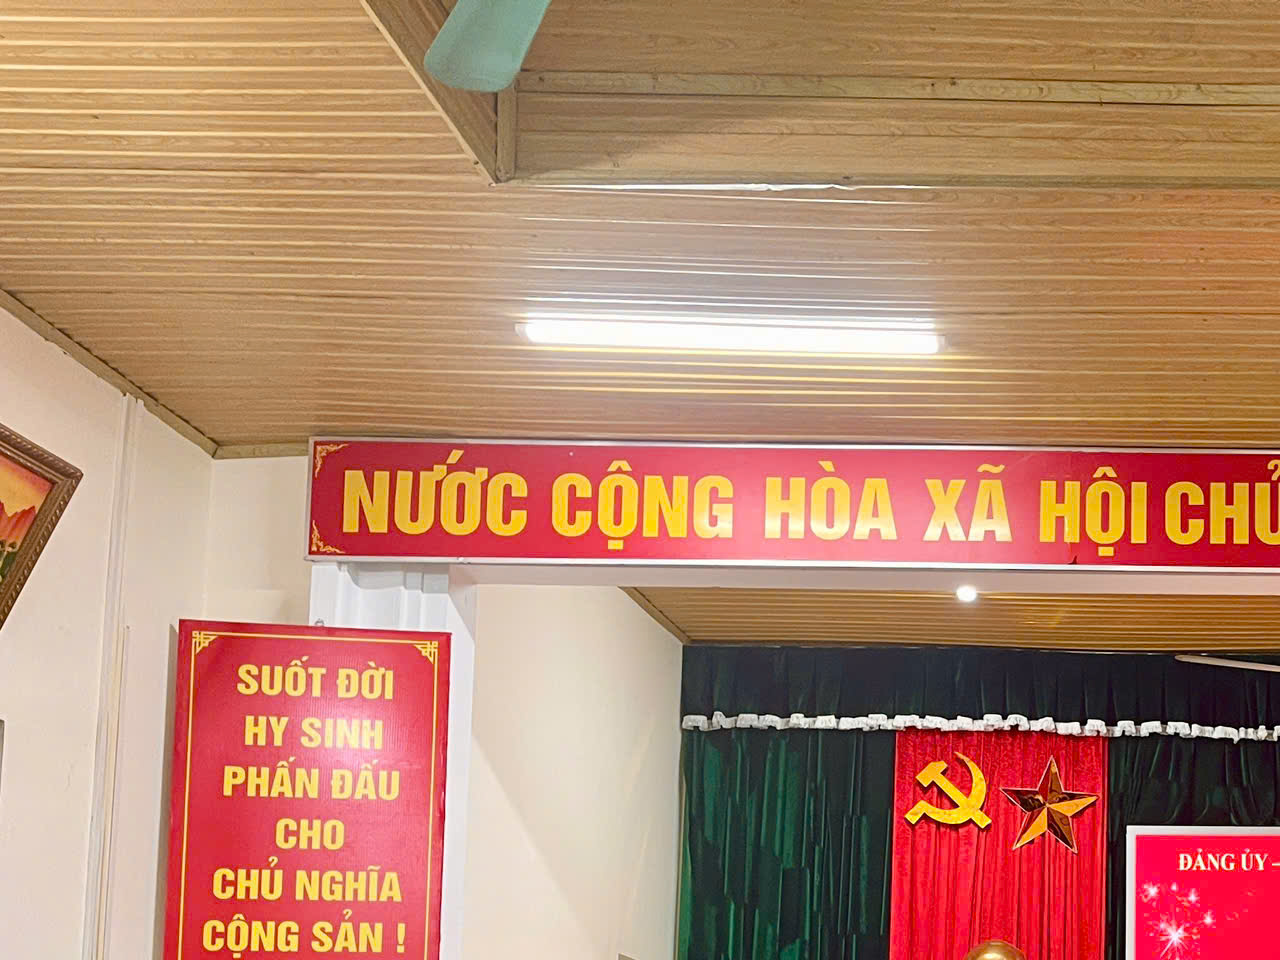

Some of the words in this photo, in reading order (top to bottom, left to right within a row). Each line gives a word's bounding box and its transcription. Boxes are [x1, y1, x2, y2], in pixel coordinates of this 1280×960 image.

[342, 451, 528, 534] NƯỚC
[551, 461, 734, 550] CỘNG
[764, 462, 887, 541] HÒA
[924, 465, 1013, 542] XÃ
[1038, 466, 1148, 556] HỘI
[237, 656, 328, 697] SUỐT
[336, 661, 394, 700] ĐỜI
[244, 715, 288, 747] HY
[301, 717, 383, 750] SINH
[223, 757, 320, 799] PHẤN
[331, 760, 400, 800] ĐẤU
[276, 819, 345, 851] CHO
[213, 857, 284, 901] CHỦ
[296, 866, 402, 902] NGHĨA
[1178, 848, 1235, 871] ĐẢNG
[1241, 848, 1268, 871] ỦY
[203, 914, 299, 959] CỘNG
[312, 910, 383, 953] SẢN
[396, 924, 405, 953] !
